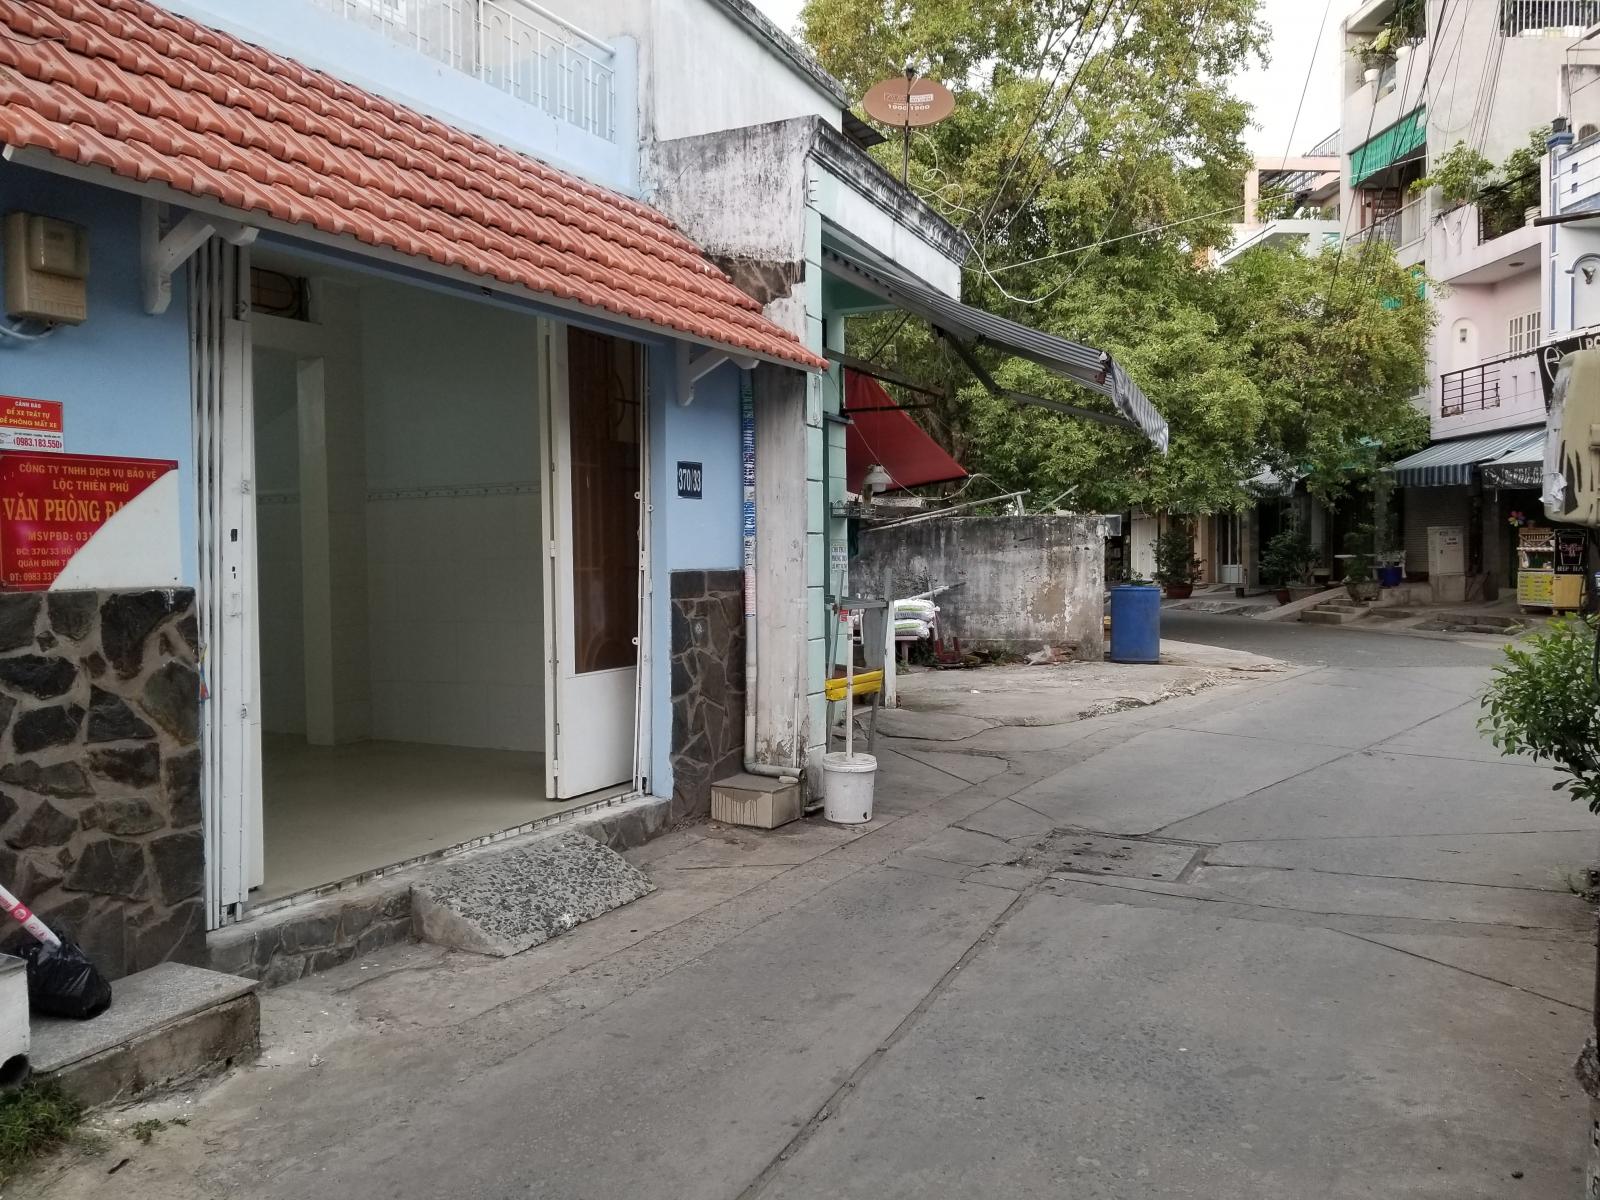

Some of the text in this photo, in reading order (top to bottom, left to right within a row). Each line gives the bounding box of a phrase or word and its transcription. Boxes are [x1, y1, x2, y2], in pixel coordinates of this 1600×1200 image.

[9, 418, 33, 427] PHÒNG
[19, 462, 45, 474] CÔNG
[47, 465, 59, 474] TY
[62, 466, 87, 475] TNHH
[89, 467, 110, 478] DỊCH
[112, 468, 124, 478] VỤ
[53, 477, 73, 491] LỘC
[109, 481, 129, 492] PHÚ
[678, 467, 701, 492] 370/33
[2, 492, 38, 521] VĂN
[44, 493, 101, 522] PHÒNG
